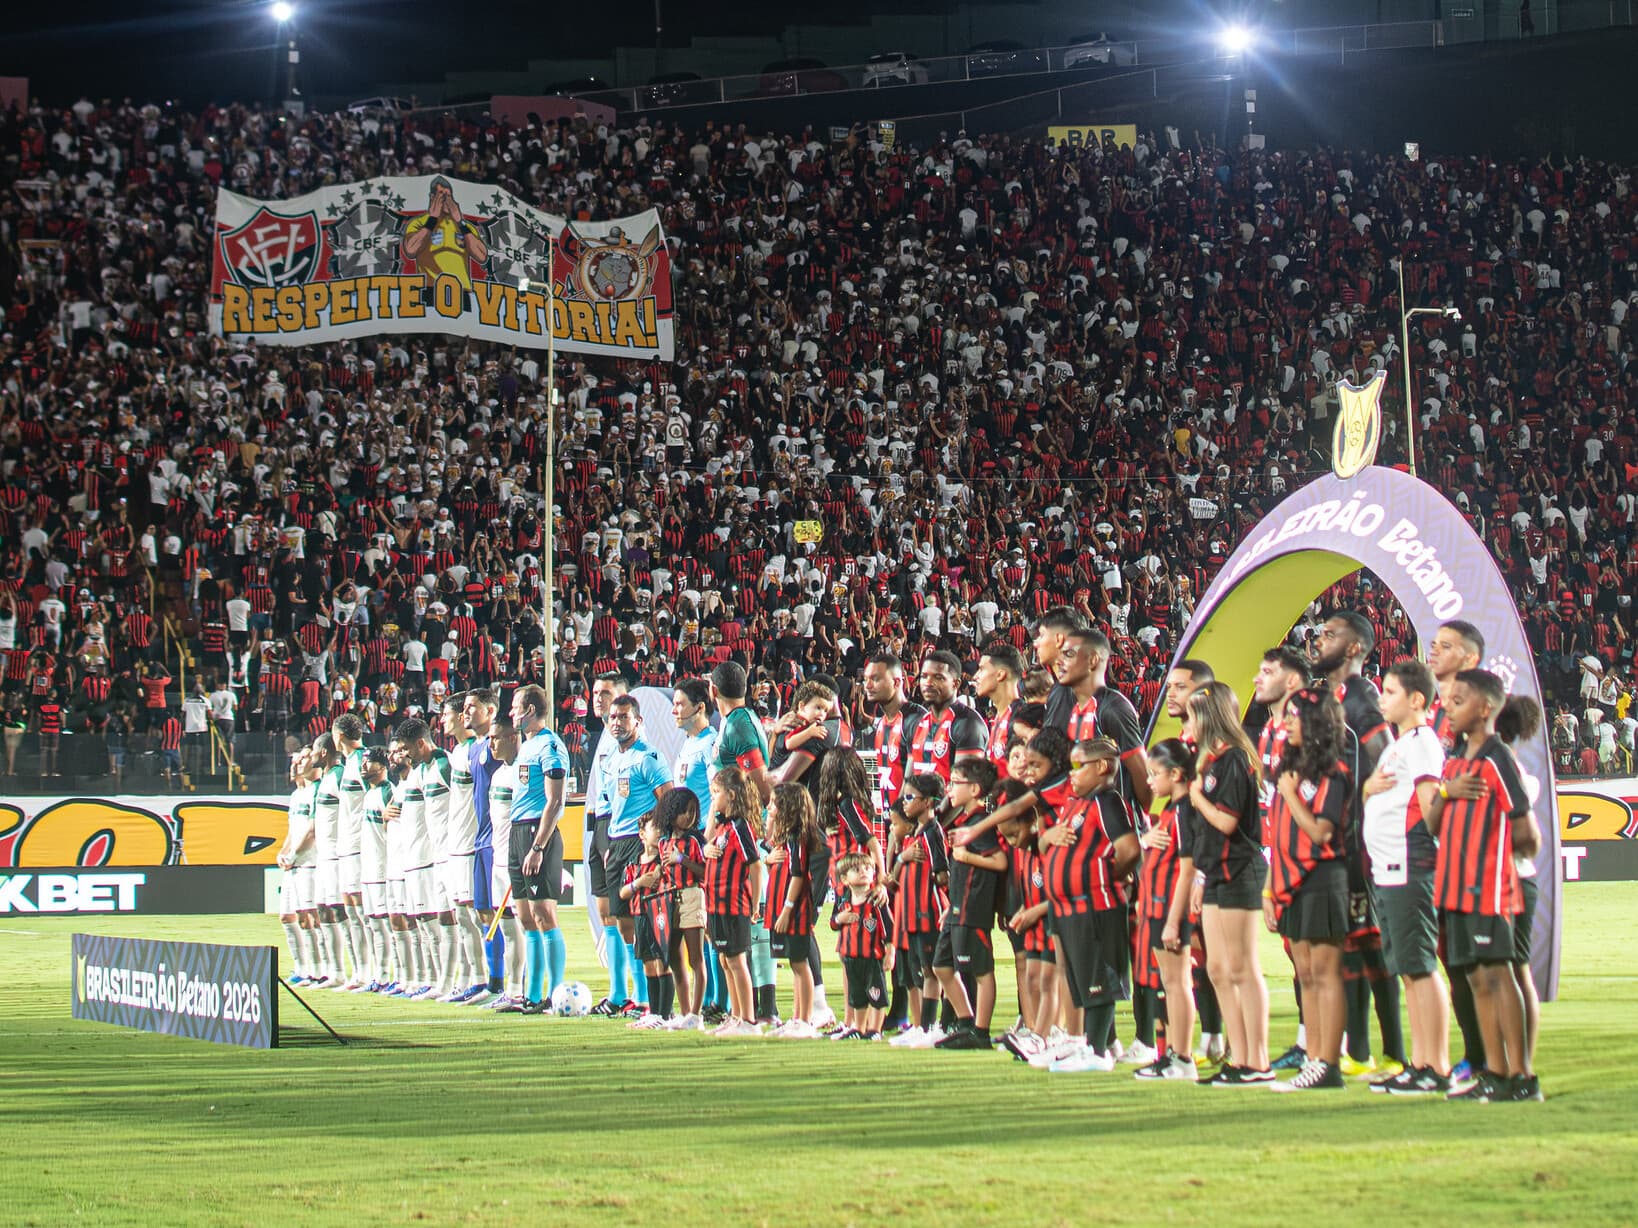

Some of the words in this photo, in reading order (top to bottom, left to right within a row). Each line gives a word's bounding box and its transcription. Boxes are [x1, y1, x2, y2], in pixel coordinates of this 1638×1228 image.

[1068, 129, 1116, 150] BAR
[354, 237, 382, 251] CBF
[505, 247, 531, 263] CBF
[222, 274, 427, 334] RESPEITE
[435, 272, 463, 320] O
[472, 279, 660, 349] VITÓRIA!
[1377, 517, 1464, 620] Betano
[86, 963, 176, 1014] BRASILEIRÃO
[177, 971, 220, 1019] Betano
[223, 981, 260, 1024] 2026
